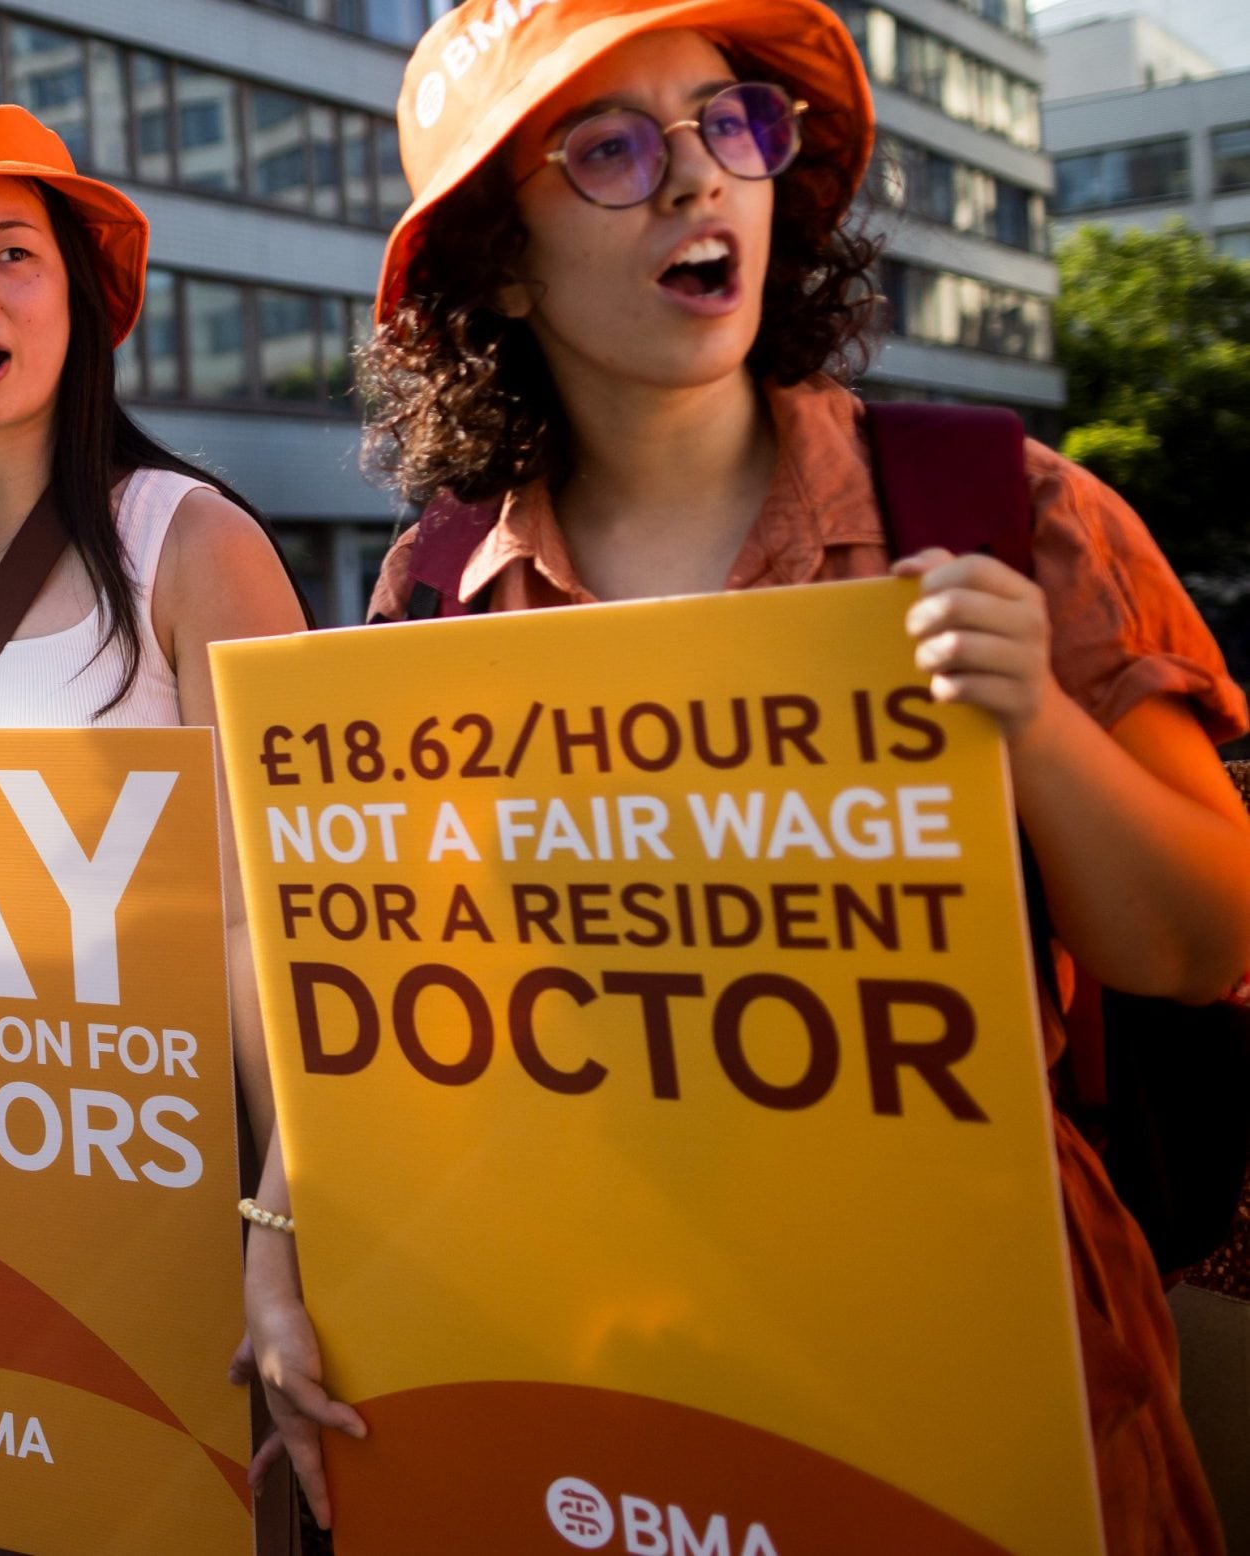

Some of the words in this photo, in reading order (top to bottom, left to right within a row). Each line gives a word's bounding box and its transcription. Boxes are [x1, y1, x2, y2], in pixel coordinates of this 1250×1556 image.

[259, 694, 828, 786] £18.62/HOUR
[854, 684, 946, 763] IS
[266, 802, 408, 864] NOT
[427, 800, 482, 862] A
[495, 794, 674, 860] FAIR
[685, 786, 962, 860] WAGE
[279, 883, 422, 942] FOR
[440, 883, 496, 943] A
[513, 883, 964, 953] RESIDENT
[87, 1023, 198, 1079] FOR
[289, 961, 989, 1123] DOCTOR
